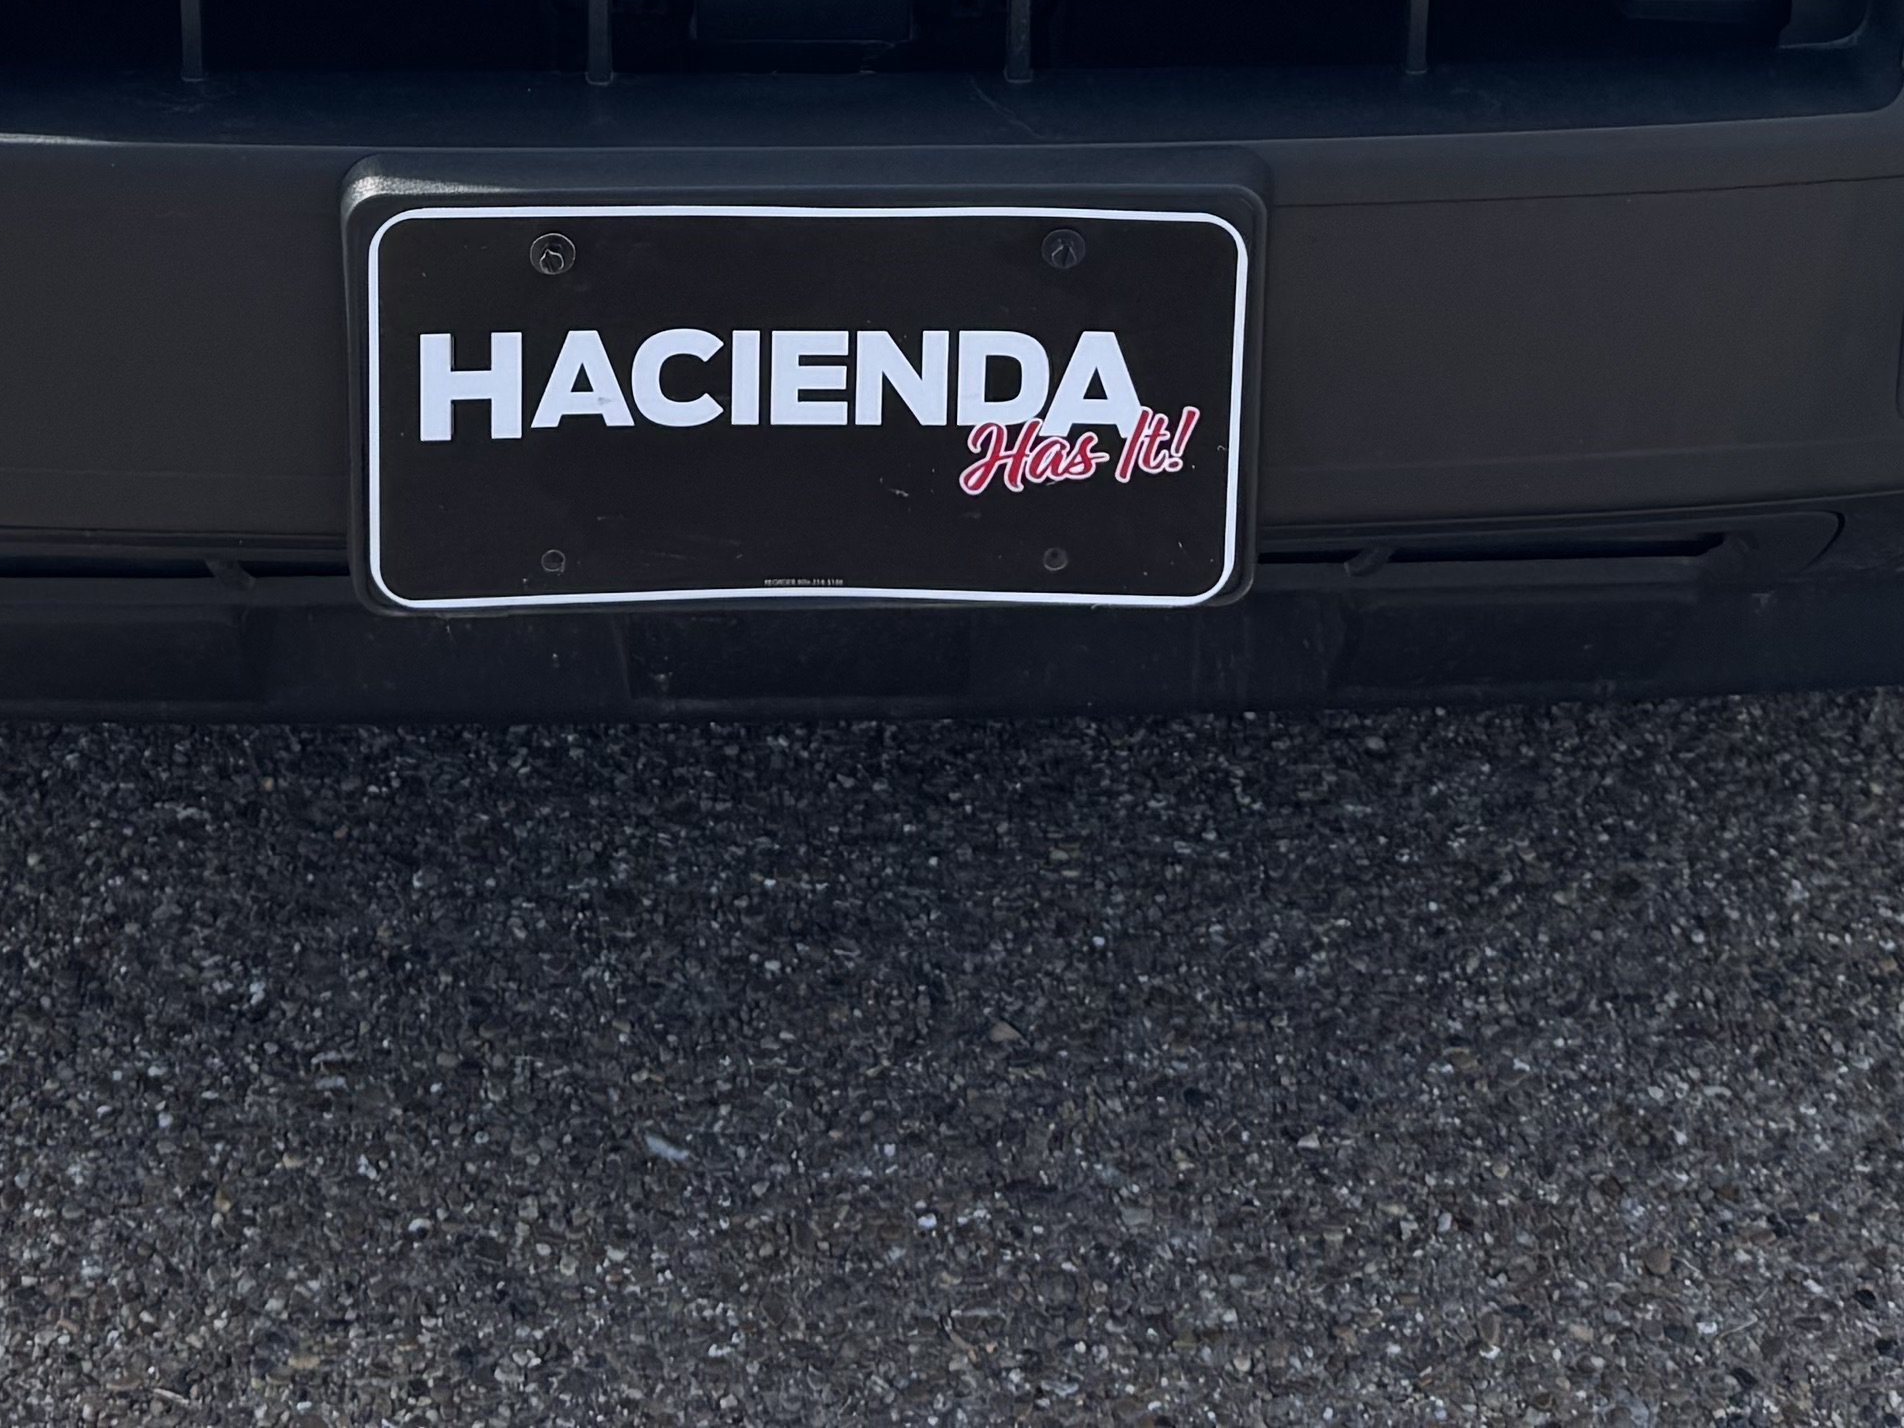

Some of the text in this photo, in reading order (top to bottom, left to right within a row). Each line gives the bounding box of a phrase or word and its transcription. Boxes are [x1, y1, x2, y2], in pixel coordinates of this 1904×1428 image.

[419, 327, 1146, 442] HACIENDA
[959, 405, 1200, 496] Has It!
